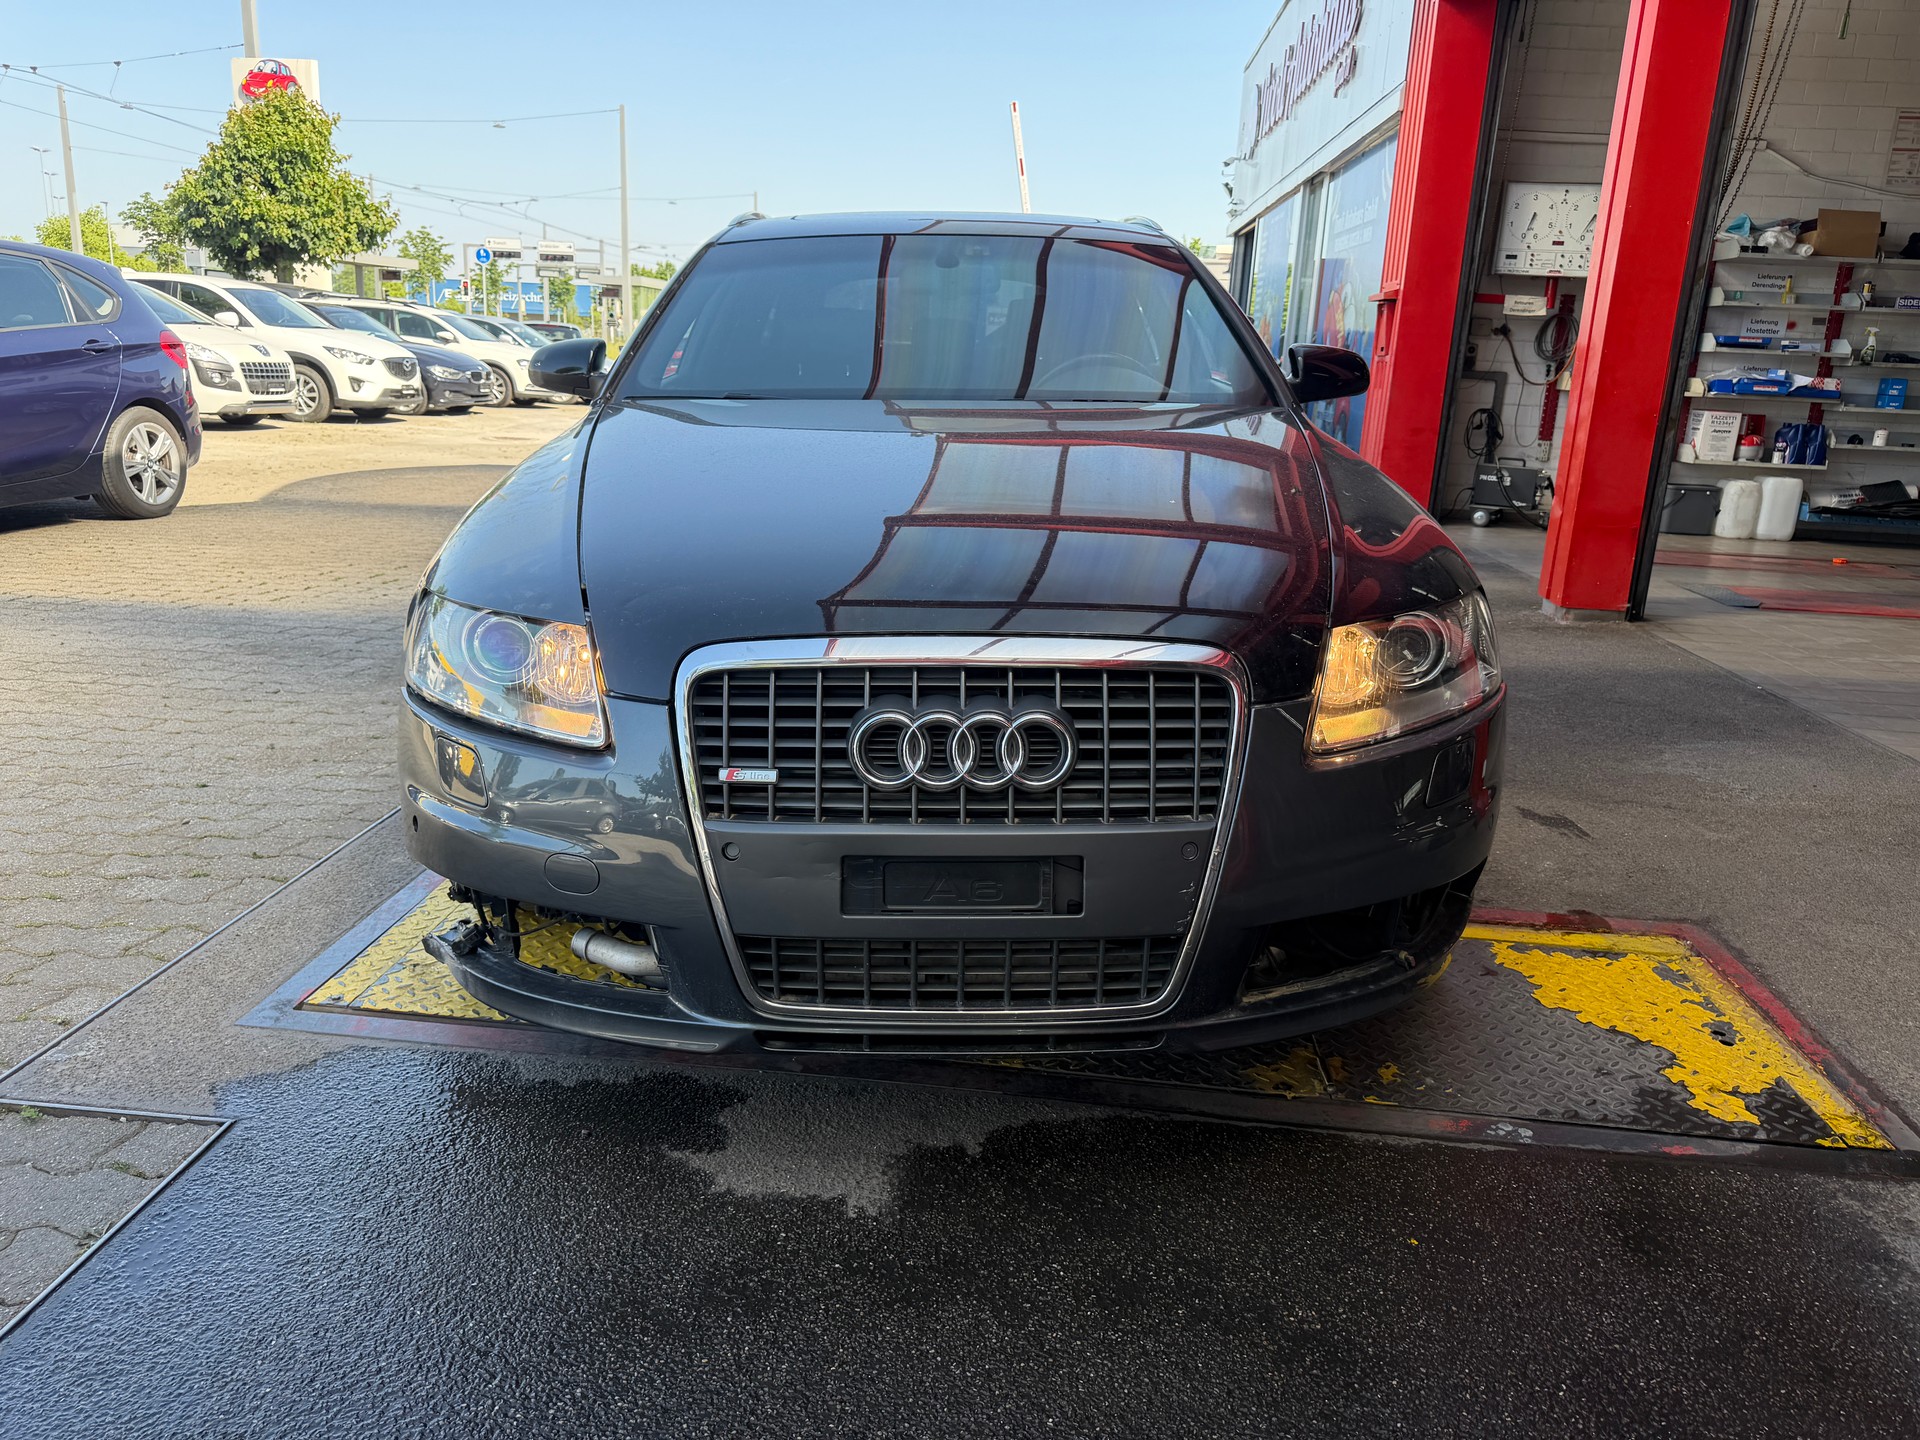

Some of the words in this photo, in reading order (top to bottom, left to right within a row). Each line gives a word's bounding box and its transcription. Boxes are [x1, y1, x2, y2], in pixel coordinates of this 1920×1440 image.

[1593, 195, 1598, 203] 3
[1751, 281, 1787, 290] Derendinge
[1750, 318, 1779, 326] Lieferung
[1745, 327, 1780, 335] Hostettler
[732, 771, 746, 780] S
[750, 771, 770, 780] line
[922, 874, 1003, 902] A6
